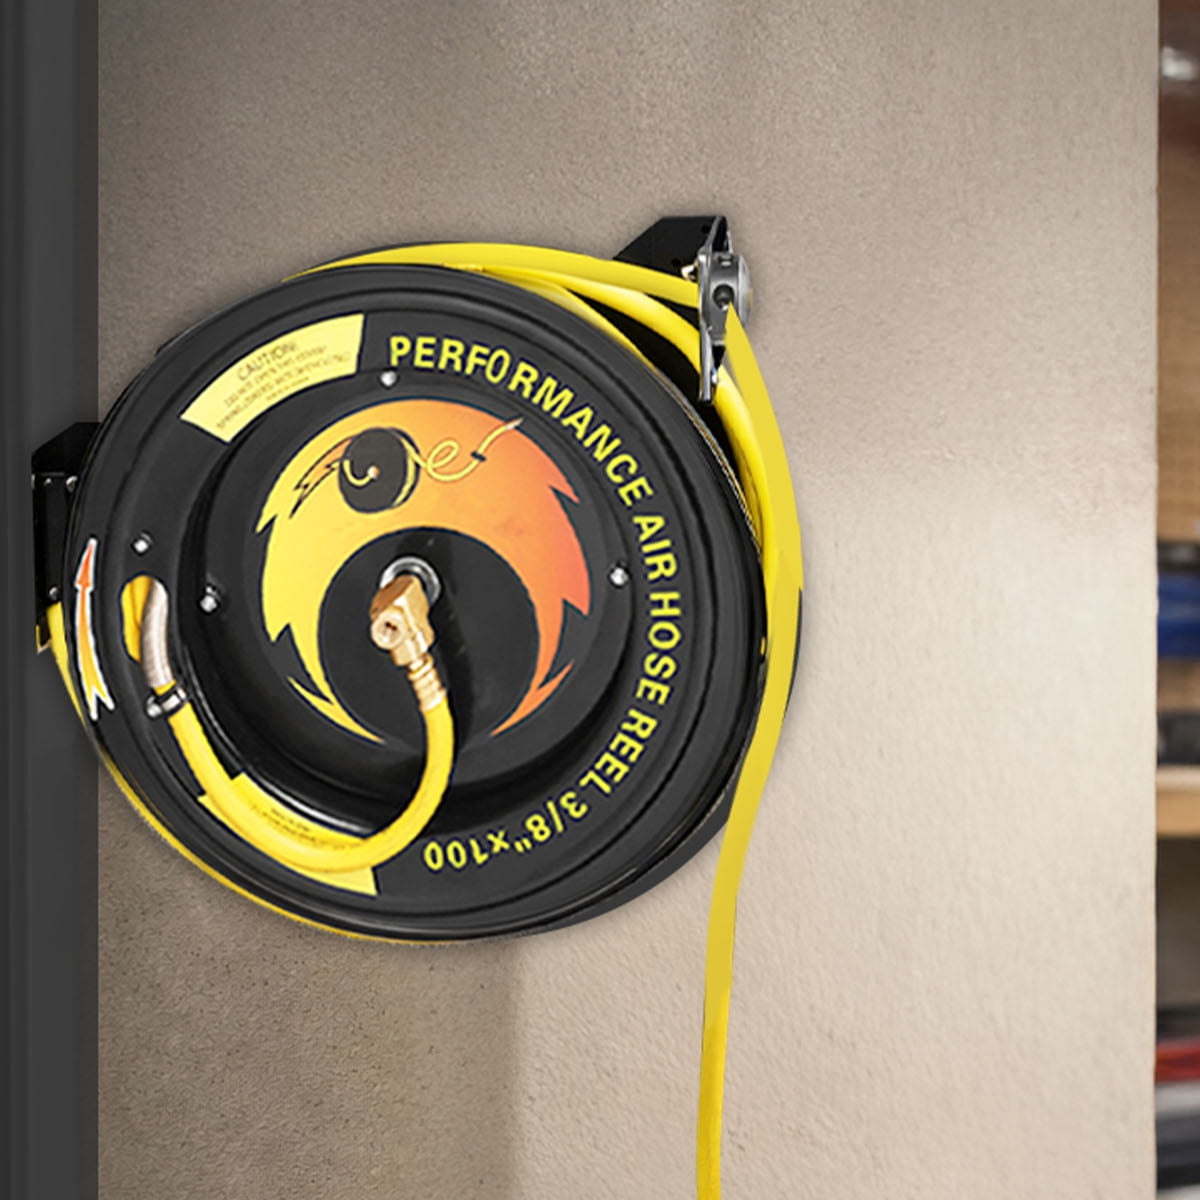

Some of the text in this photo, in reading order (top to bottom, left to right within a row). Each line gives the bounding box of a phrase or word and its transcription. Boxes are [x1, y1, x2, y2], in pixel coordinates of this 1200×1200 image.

[389, 335, 654, 507] PERFORMANCE
[632, 515, 677, 580] AIR
[636, 591, 681, 705] HOSE
[579, 708, 658, 793] REEL
